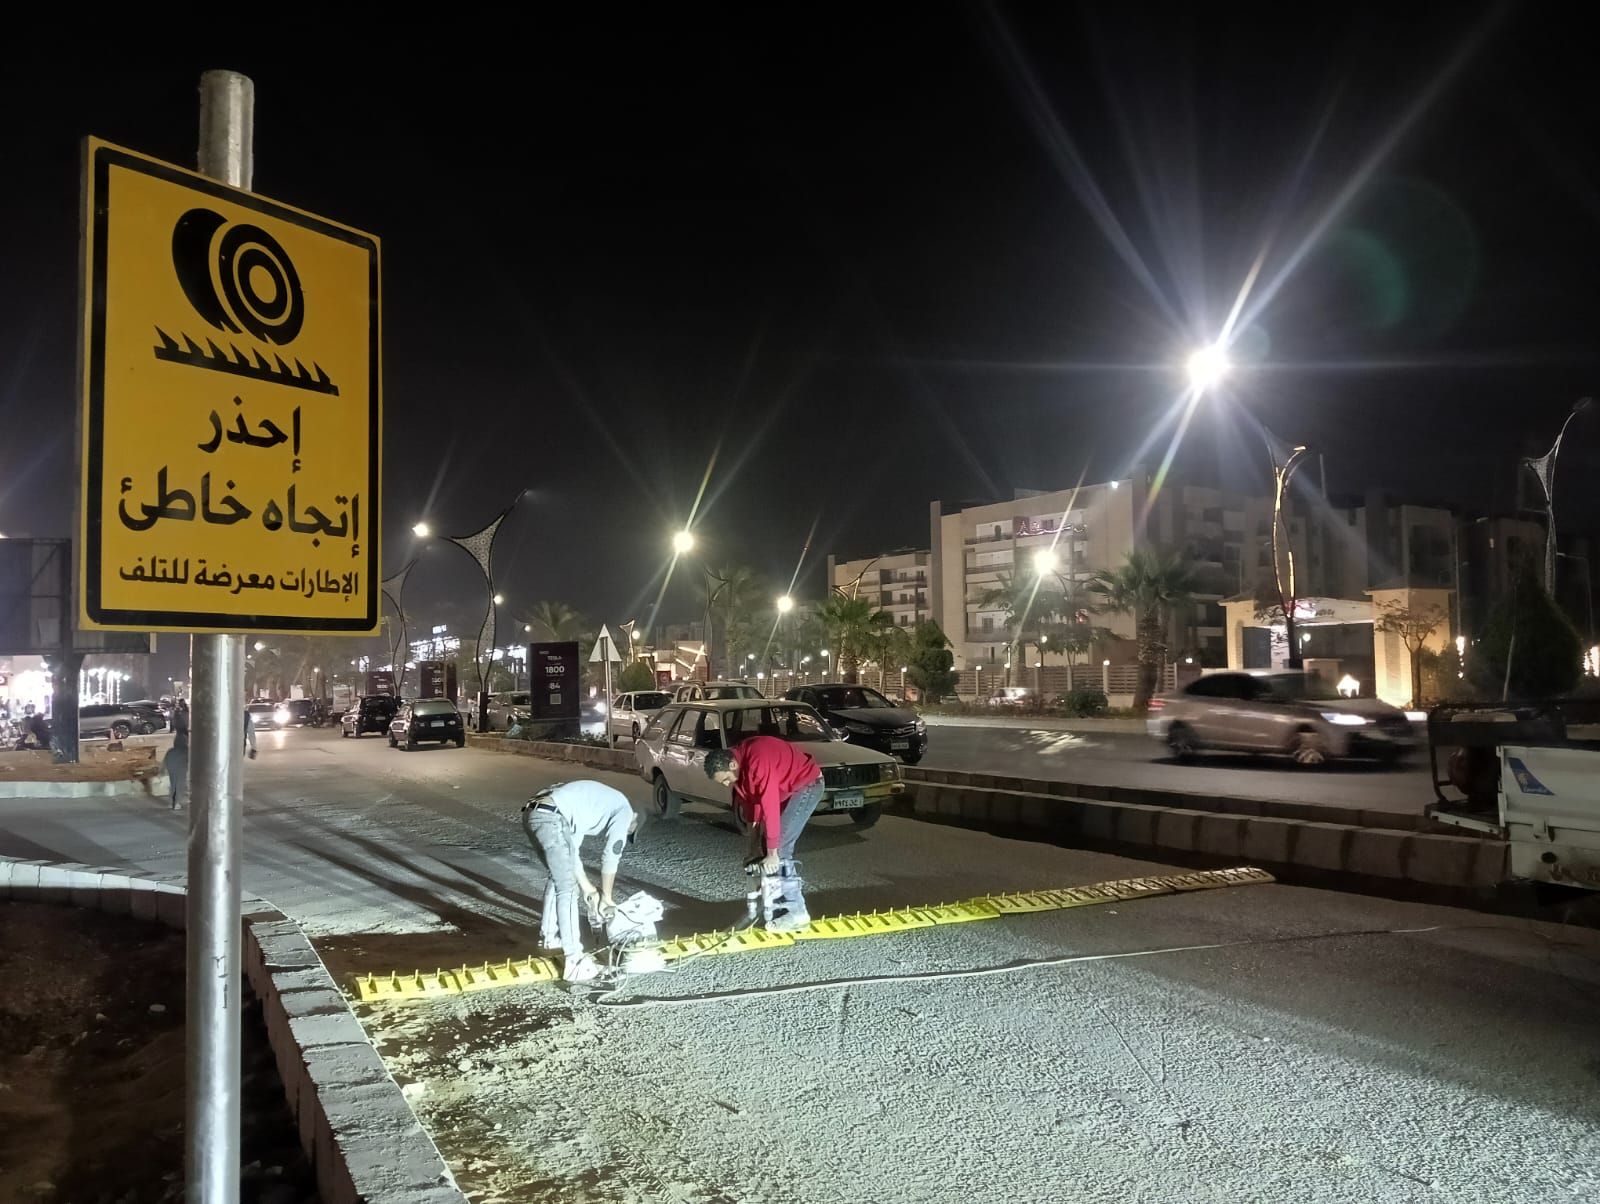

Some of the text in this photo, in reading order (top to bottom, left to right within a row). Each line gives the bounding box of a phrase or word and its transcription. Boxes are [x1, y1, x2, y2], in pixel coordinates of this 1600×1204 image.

[198, 395, 302, 474] إحذر
[118, 465, 360, 558] إتجاه خاطئ
[119, 555, 359, 602] الإطارات معرضة للتلف
[544, 665, 565, 674] 1800
